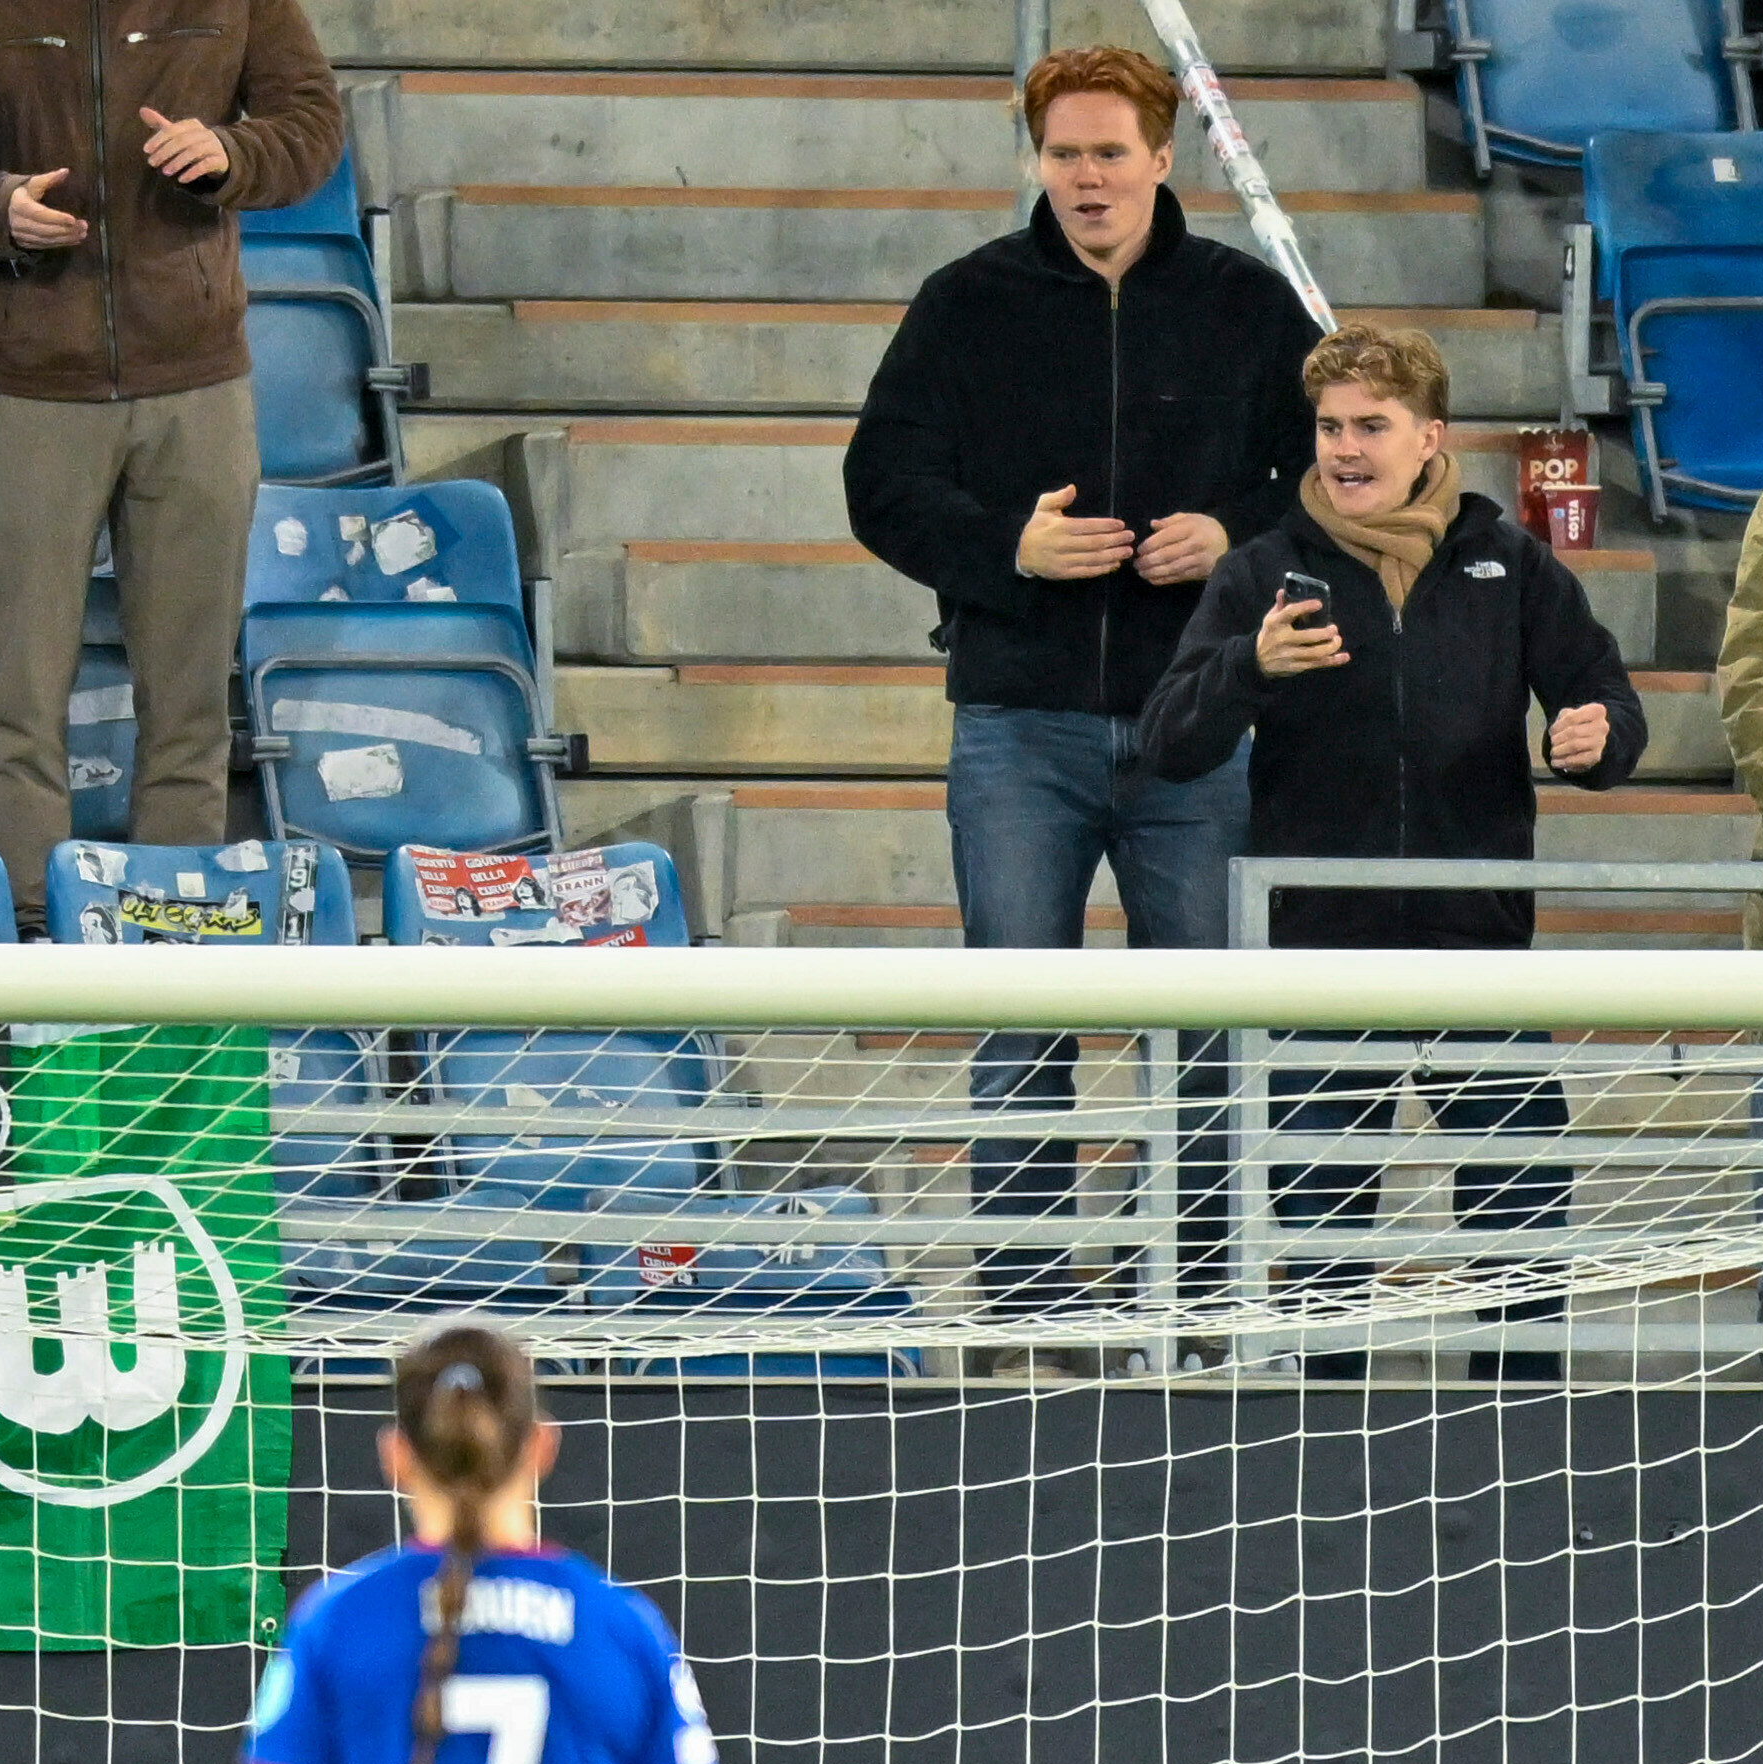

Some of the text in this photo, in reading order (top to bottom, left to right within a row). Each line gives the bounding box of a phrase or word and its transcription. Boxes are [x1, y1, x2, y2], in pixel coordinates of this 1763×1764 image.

[1529, 458, 1578, 480] POP
[1568, 500, 1580, 541] COSTA
[470, 869, 507, 883] DELLA
[556, 876, 604, 892] BRANN
